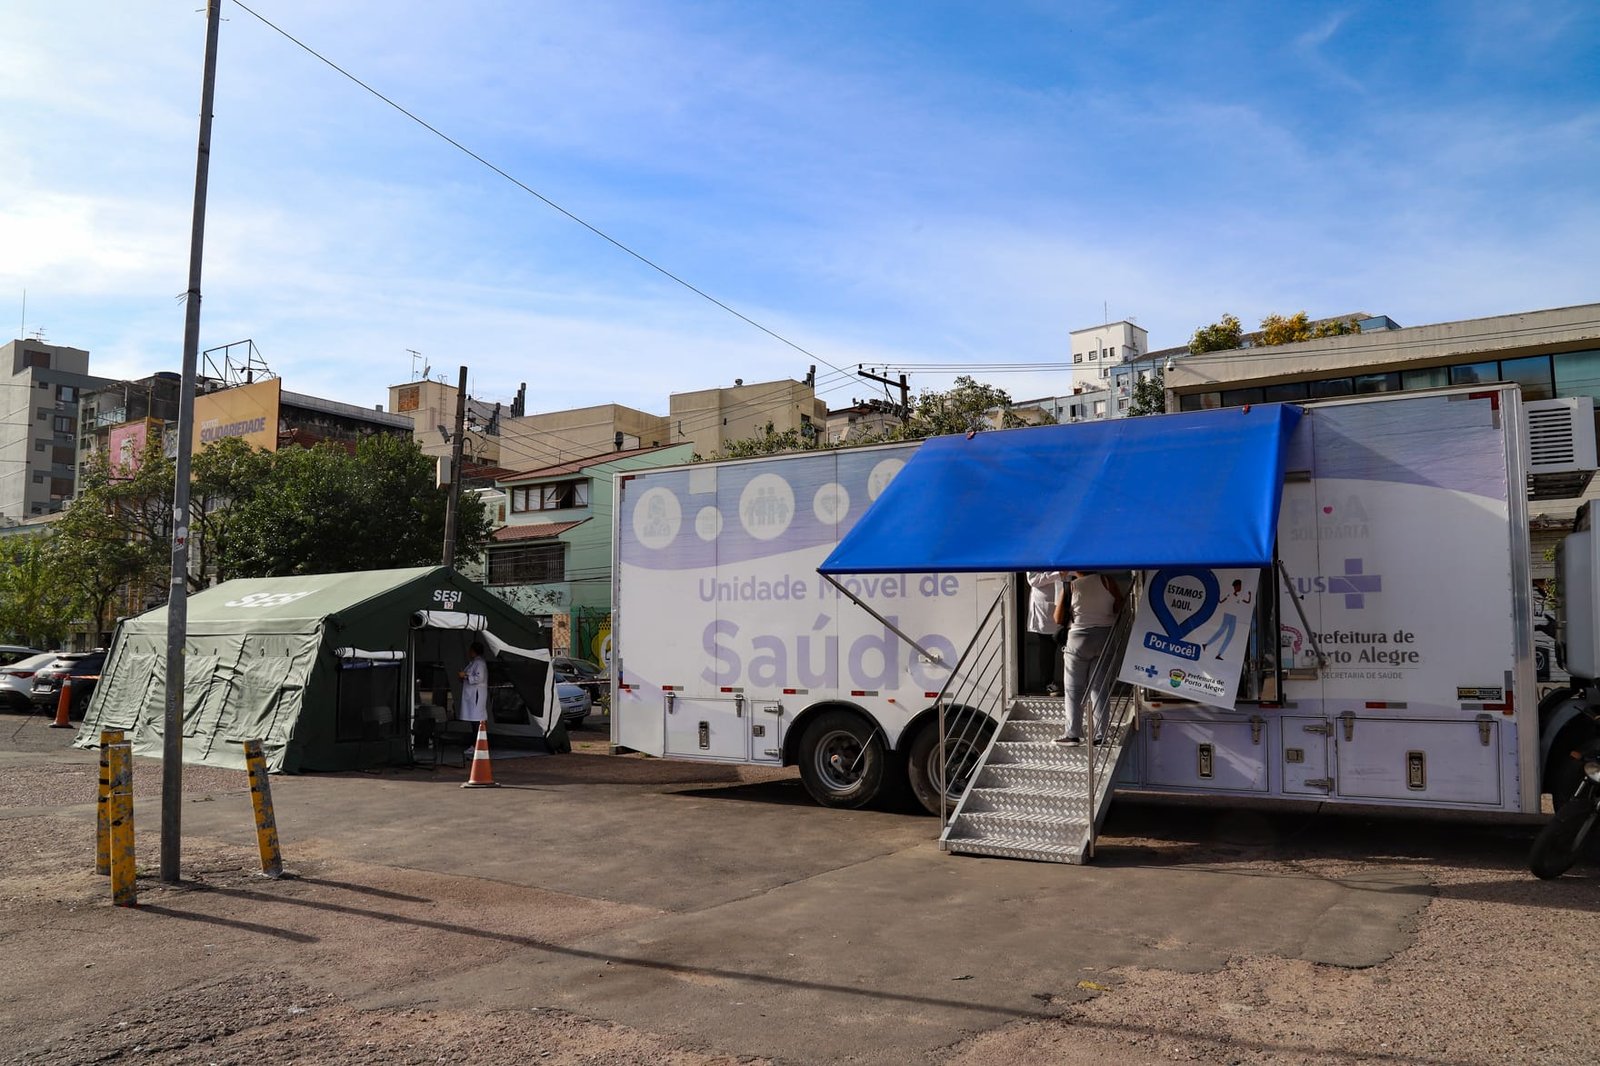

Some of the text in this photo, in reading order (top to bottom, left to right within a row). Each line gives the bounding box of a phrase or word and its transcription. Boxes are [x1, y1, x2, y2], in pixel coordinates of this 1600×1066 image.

[200, 417, 266, 442] SOLIDARIEDADE
[433, 590, 462, 602] SESI
[699, 573, 959, 602] Unidade Móvel de
[1168, 585, 1204, 599] ESTAMOS
[1309, 630, 1415, 644] Prefeitura de
[701, 613, 959, 691] Saúde
[1149, 635, 1196, 657] Por você!
[1358, 646, 1420, 666] Alegre
[1321, 672, 1365, 680] SECRETARIA
[1366, 672, 1376, 680] DE
[1184, 678, 1202, 687] Porto
[1203, 683, 1225, 693] Alegre
